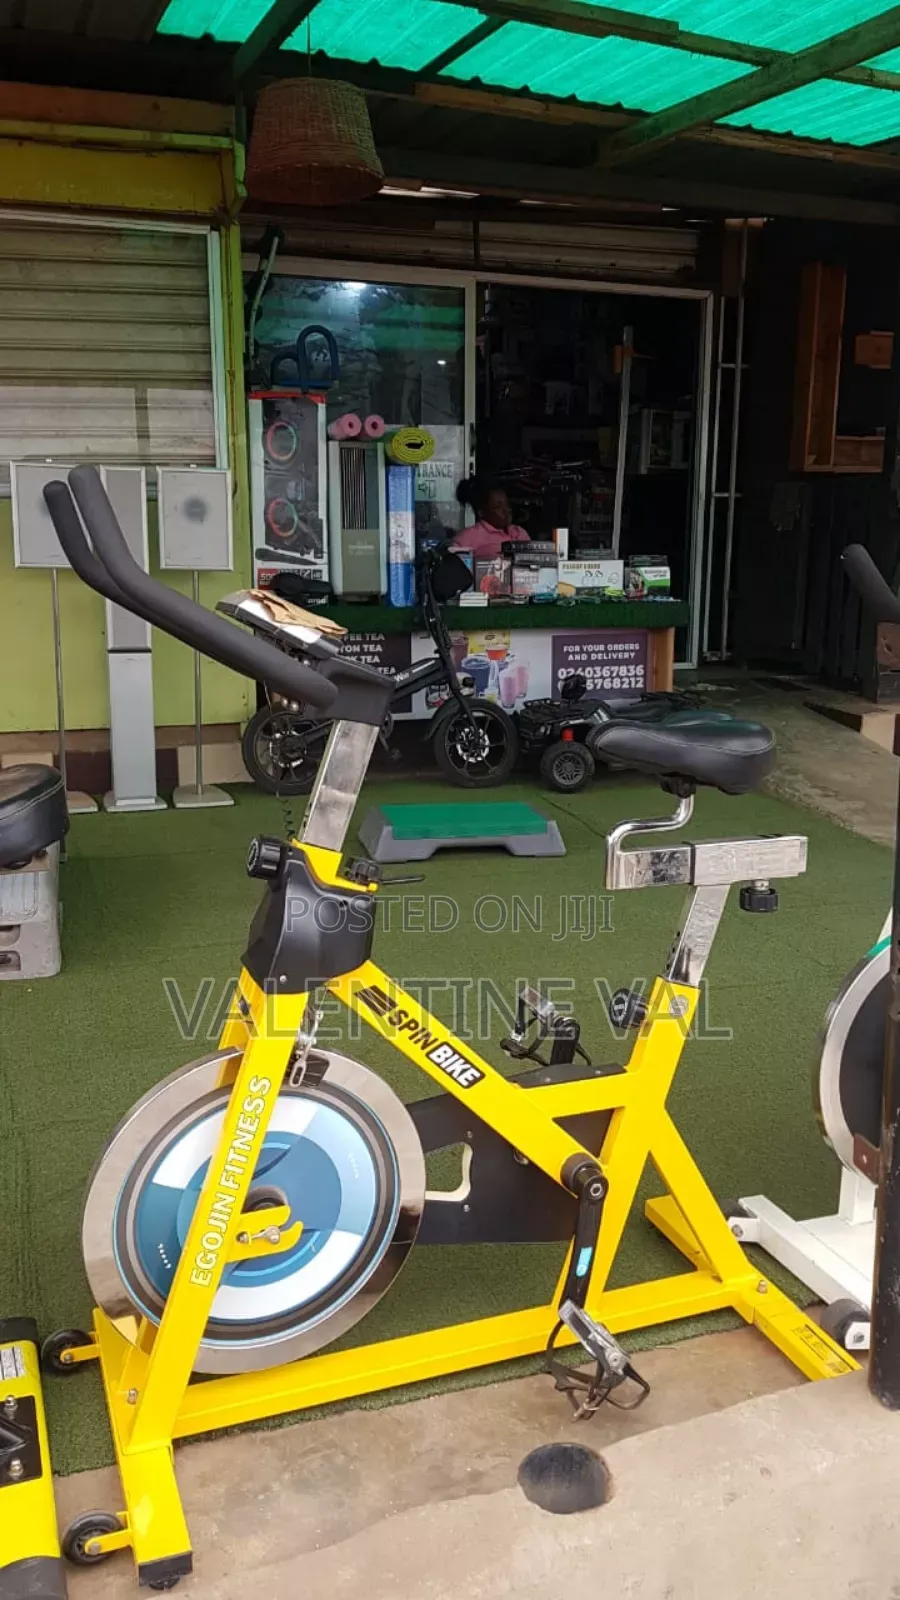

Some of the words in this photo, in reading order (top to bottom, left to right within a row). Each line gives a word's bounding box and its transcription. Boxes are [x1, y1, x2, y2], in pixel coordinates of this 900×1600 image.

[366, 633, 385, 641] TEA
[362, 644, 383, 652] TEA
[563, 645, 580, 653] FOR
[582, 644, 605, 652] YOUR
[606, 643, 640, 651] ORDERS
[359, 655, 381, 665] TEA
[568, 653, 588, 661] AND
[590, 652, 636, 660] DELIVERY
[377, 667, 396, 675] TEA
[388, 1009, 439, 1051] SPIN
[428, 1043, 481, 1087] BIKE
[190, 1189, 235, 1287] EGOJIN
[219, 1075, 272, 1191] FITNESS
